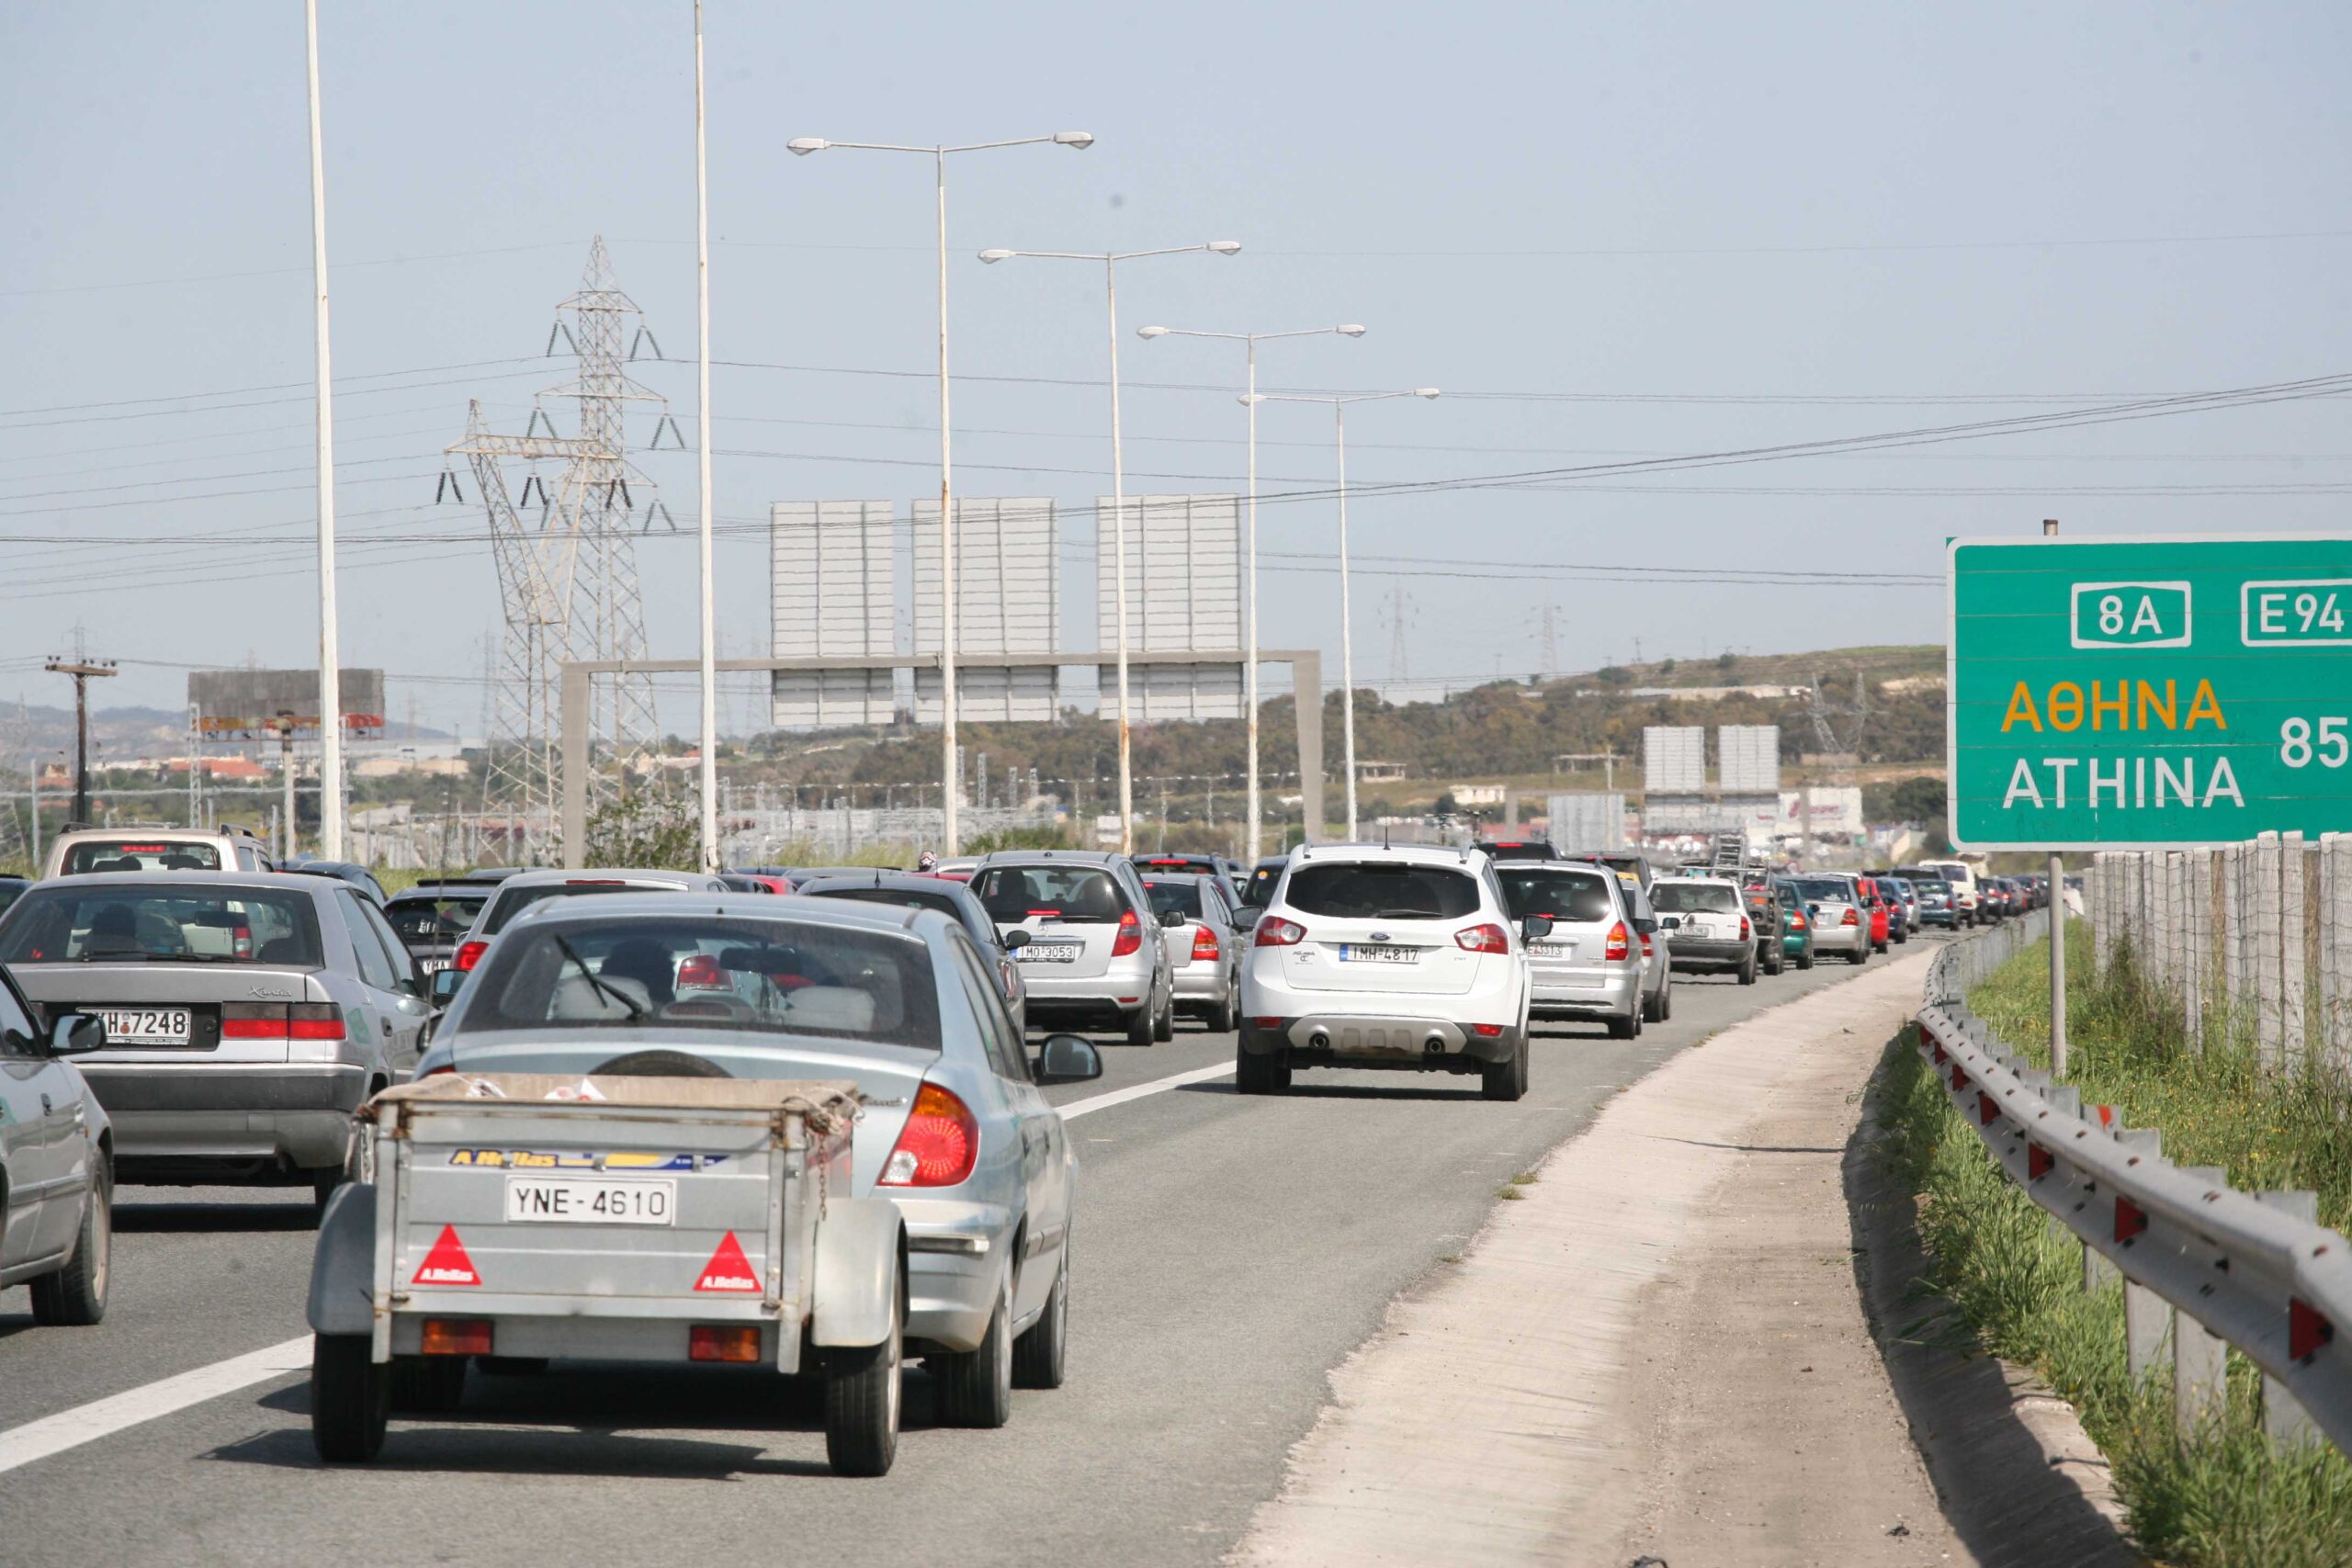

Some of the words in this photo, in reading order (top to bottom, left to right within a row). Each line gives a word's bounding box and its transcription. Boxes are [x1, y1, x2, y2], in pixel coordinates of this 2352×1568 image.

[2000, 678, 2228, 732] ΑΘΗΝΑ
[2280, 716, 2349, 769] 85
[2002, 756, 2245, 808] ATHINA
